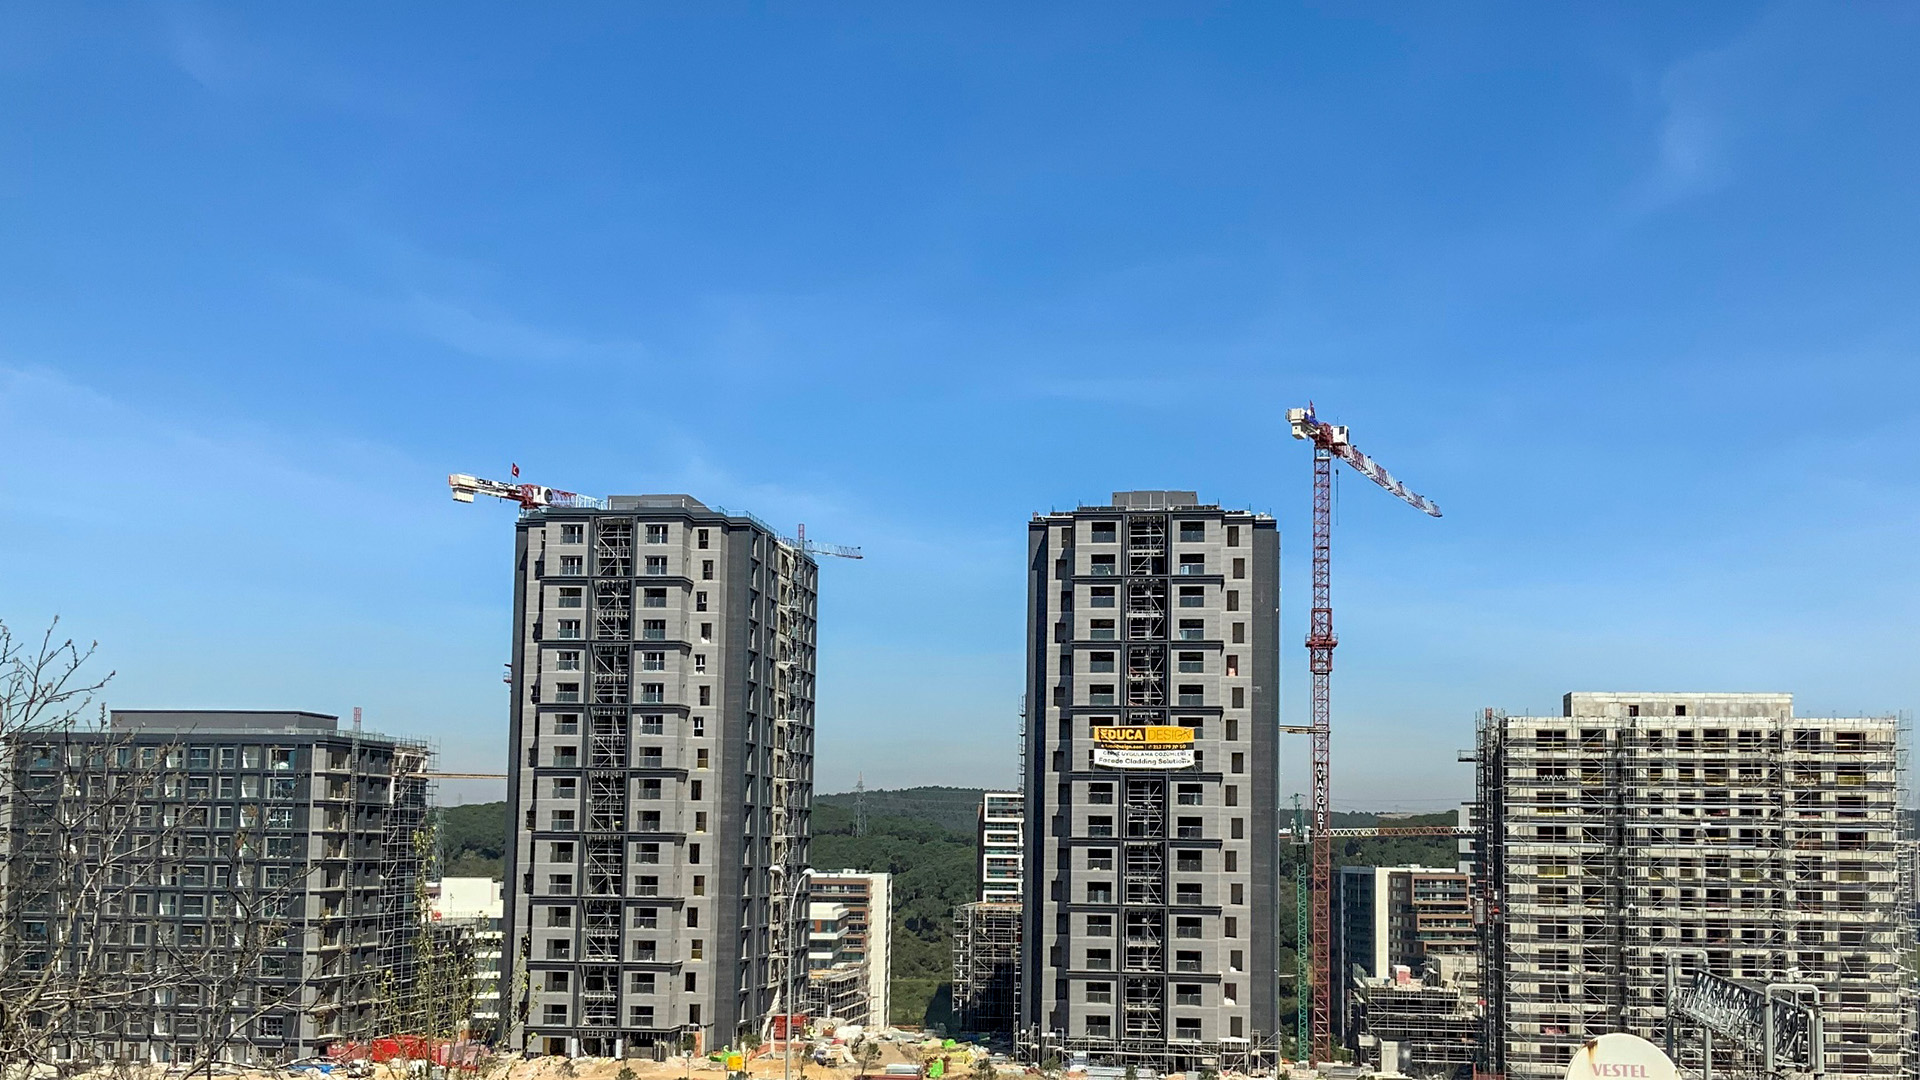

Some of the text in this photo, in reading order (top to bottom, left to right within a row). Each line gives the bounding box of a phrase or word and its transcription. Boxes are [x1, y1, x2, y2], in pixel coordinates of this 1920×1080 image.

[1147, 728, 1191, 741] DESIGN
[1125, 758, 1157, 766] Cladding
[1316, 763, 1325, 830] AVANGART
[1592, 1063, 1650, 1078] VESTEL
